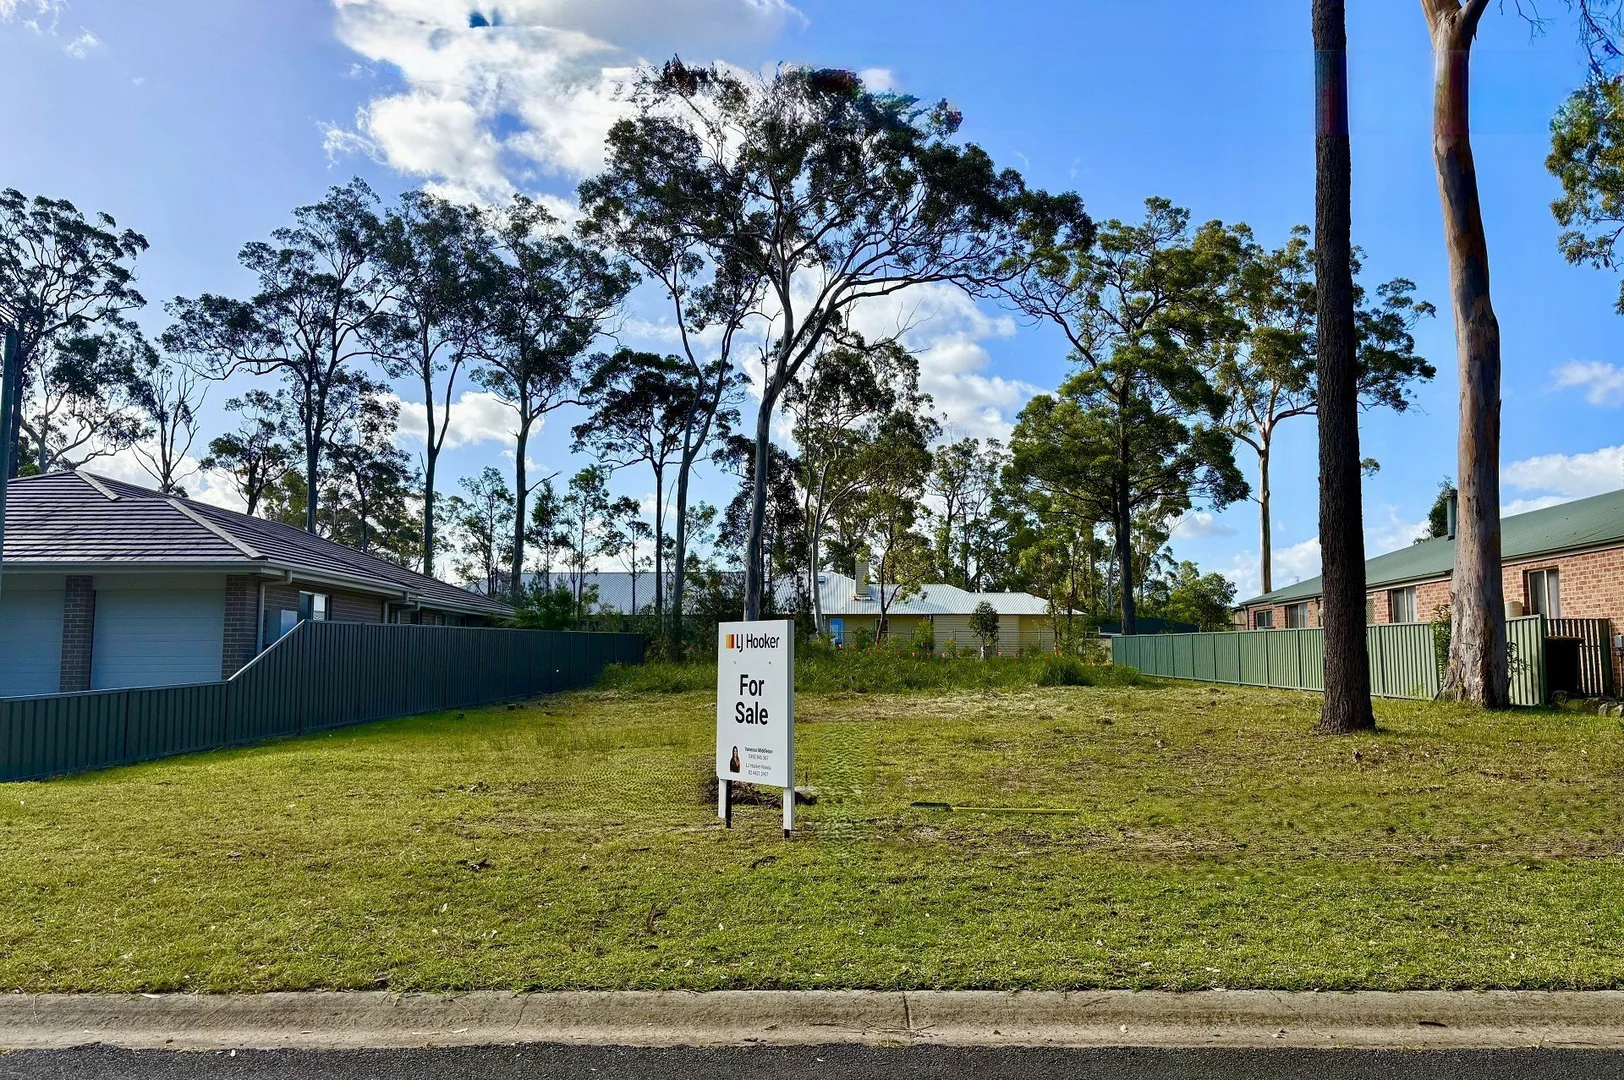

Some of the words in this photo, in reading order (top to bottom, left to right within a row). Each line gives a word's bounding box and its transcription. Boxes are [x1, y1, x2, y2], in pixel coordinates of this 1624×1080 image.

[736, 633, 743, 652] LJ
[746, 633, 780, 649] Hooker
[740, 674, 764, 696] For
[735, 701, 768, 725] Sale
